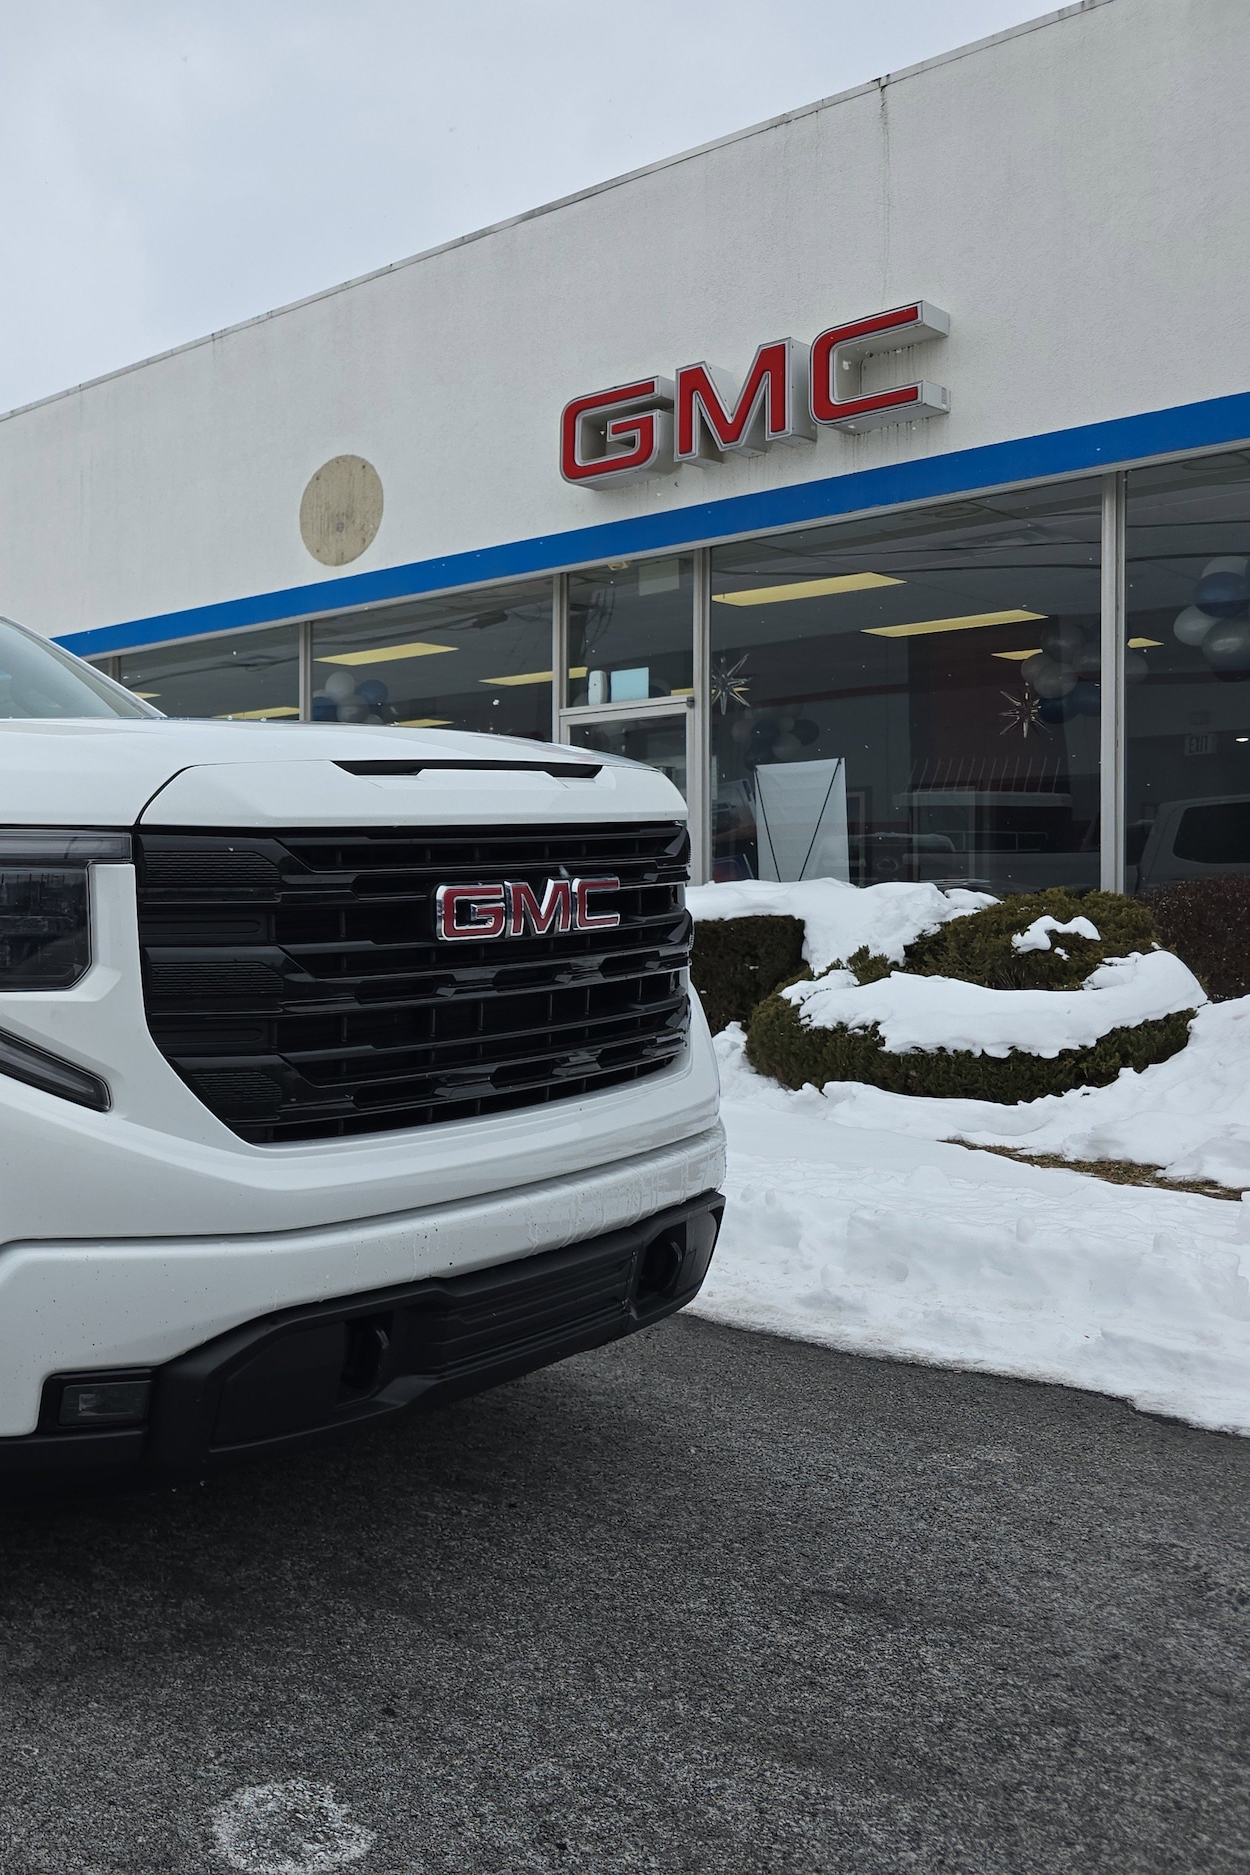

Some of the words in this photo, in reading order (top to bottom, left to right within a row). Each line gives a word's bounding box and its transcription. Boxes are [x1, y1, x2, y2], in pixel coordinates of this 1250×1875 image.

[561, 301, 948, 490] GMC
[1189, 736, 1210, 753] EXIT
[436, 877, 620, 941] GMC
